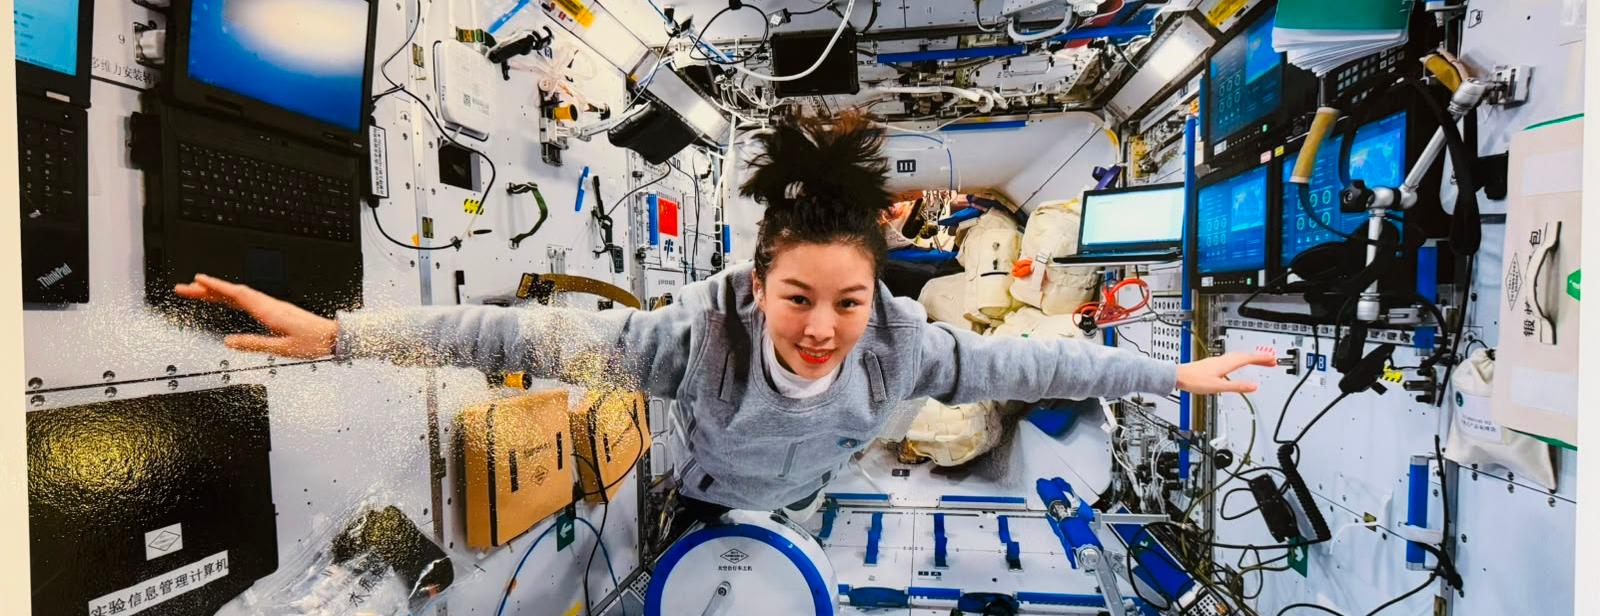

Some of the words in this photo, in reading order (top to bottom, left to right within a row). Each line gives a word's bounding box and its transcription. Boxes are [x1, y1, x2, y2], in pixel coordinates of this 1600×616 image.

[37, 262, 72, 288] ThinkPad
[90, 557, 229, 616] 实验信息管理计算机
